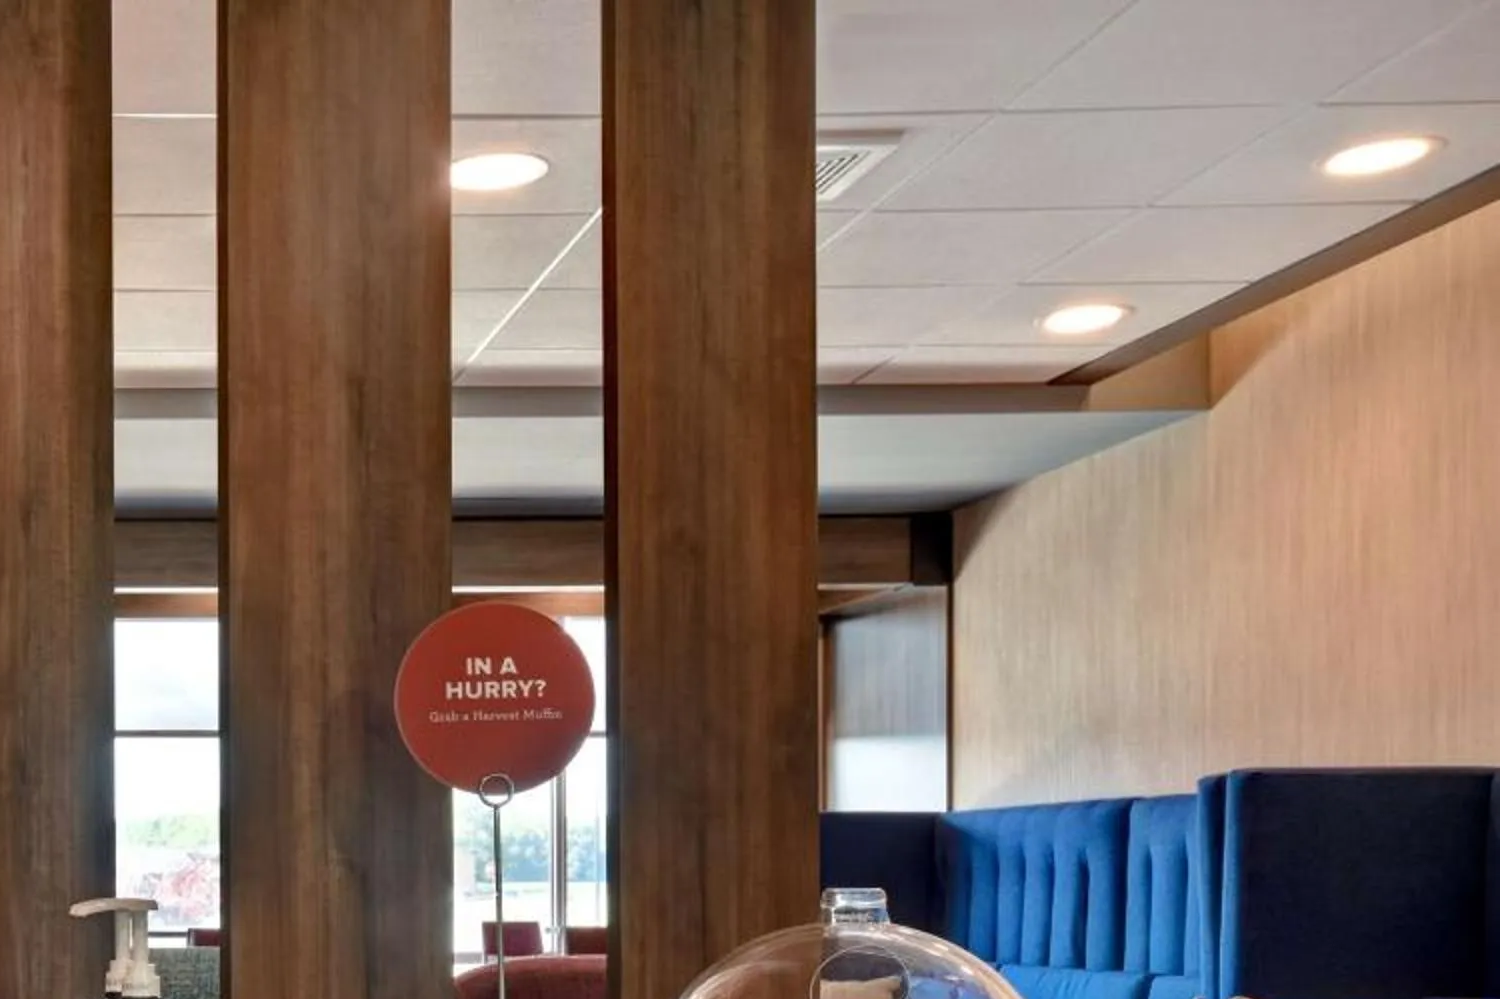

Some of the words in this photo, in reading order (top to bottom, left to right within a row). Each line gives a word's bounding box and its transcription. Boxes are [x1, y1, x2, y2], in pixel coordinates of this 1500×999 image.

[465, 657, 492, 676] IN
[499, 656, 519, 674] A
[445, 679, 547, 700] HURRY?
[429, 710, 458, 723] Grab
[461, 713, 469, 721] a
[473, 709, 520, 722] Harvest
[522, 708, 563, 721] Muffin
